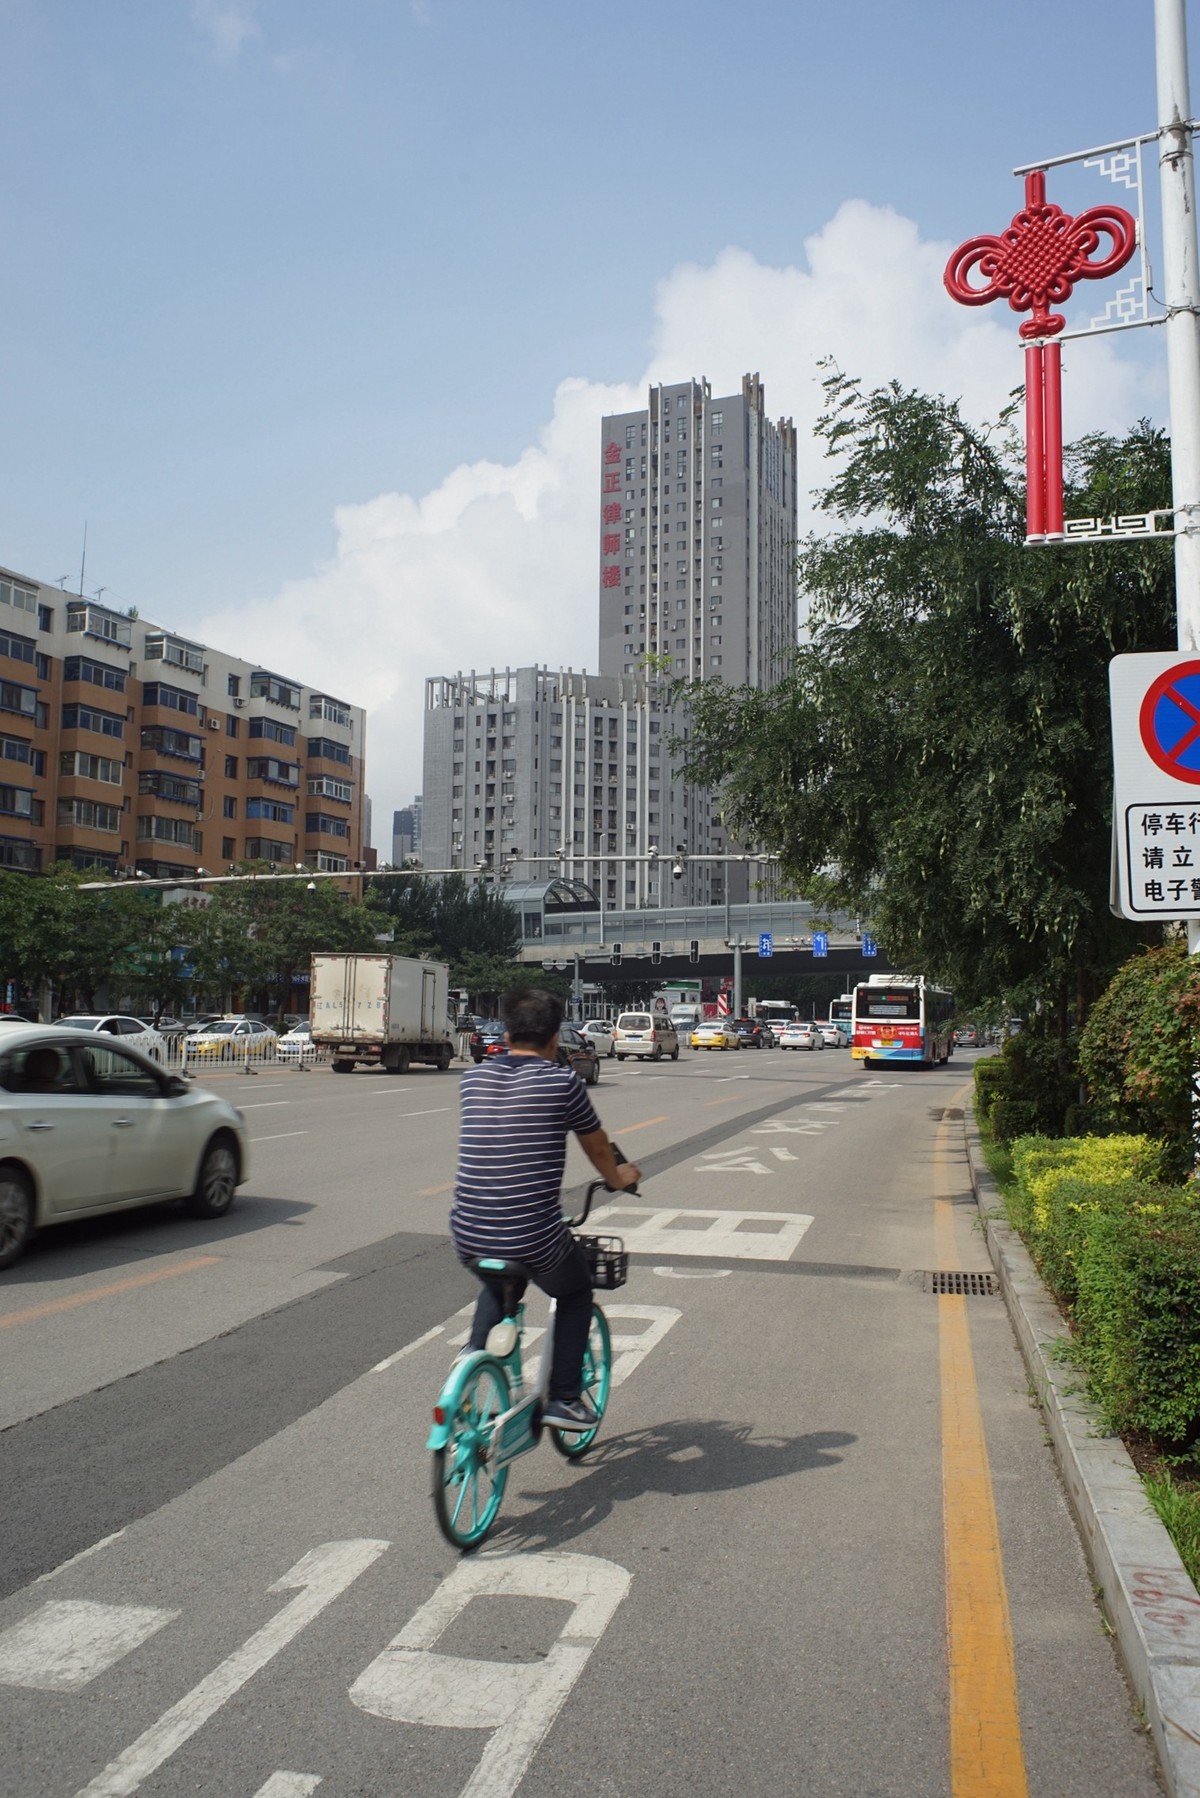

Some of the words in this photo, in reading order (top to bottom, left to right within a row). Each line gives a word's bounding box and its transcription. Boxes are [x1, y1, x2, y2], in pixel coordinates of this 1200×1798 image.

[602, 441, 622, 588] 金正律师楼
[1142, 845, 1194, 869] 请立
